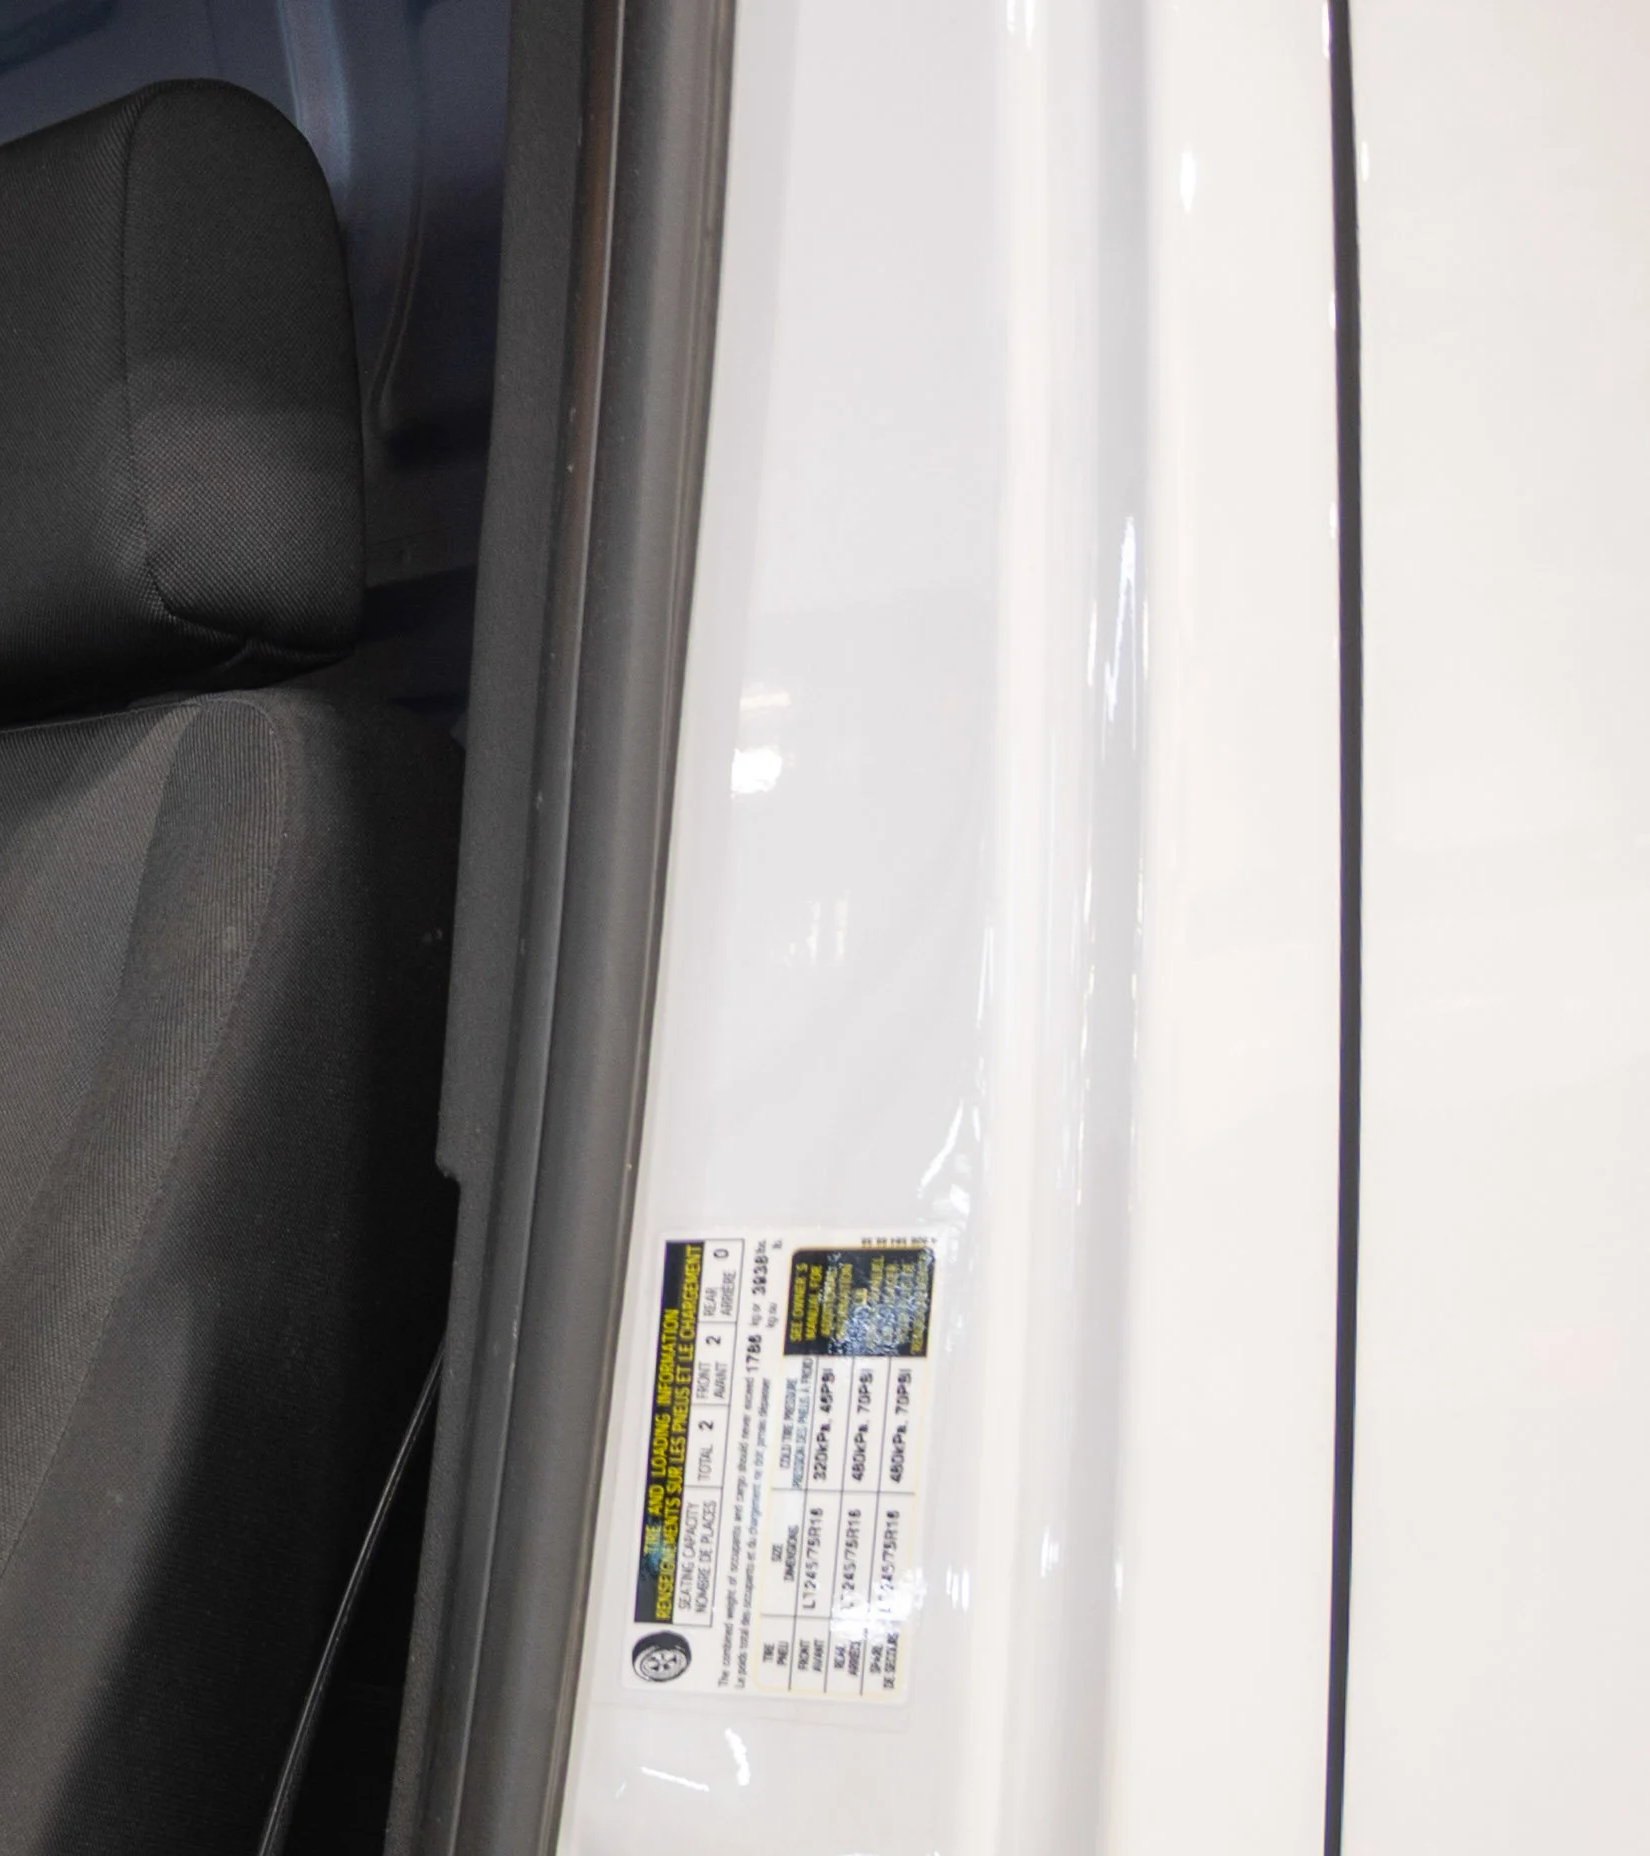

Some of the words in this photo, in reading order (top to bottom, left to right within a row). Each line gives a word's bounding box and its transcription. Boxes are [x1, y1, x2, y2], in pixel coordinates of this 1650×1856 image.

[678, 1244, 702, 1339] CHARGEMENT
[702, 1287, 718, 1315] REAR
[656, 1308, 680, 1404] INFORMATION
[677, 1344, 695, 1360] LE
[705, 1335, 721, 1344] 2
[675, 1366, 693, 1384] ET
[695, 1360, 711, 1399] FRONT
[671, 1387, 691, 1431] PNEUS
[697, 1420, 714, 1431] 2
[650, 1413, 672, 1475] LOADING
[668, 1435, 687, 1461] LES
[696, 1444, 713, 1481] TOTAL
[665, 1466, 684, 1493] SUR
[647, 1484, 665, 1516] AND
[643, 1524, 661, 1555] TIRE
[682, 1501, 700, 1557] CAPACITY
[699, 1500, 717, 1544] PLACES
[698, 1546, 713, 1563] DE
[839, 1508, 861, 1608] 245/75R16
[677, 1560, 694, 1611] SEATING
[693, 1566, 711, 1613] NOMBRE
